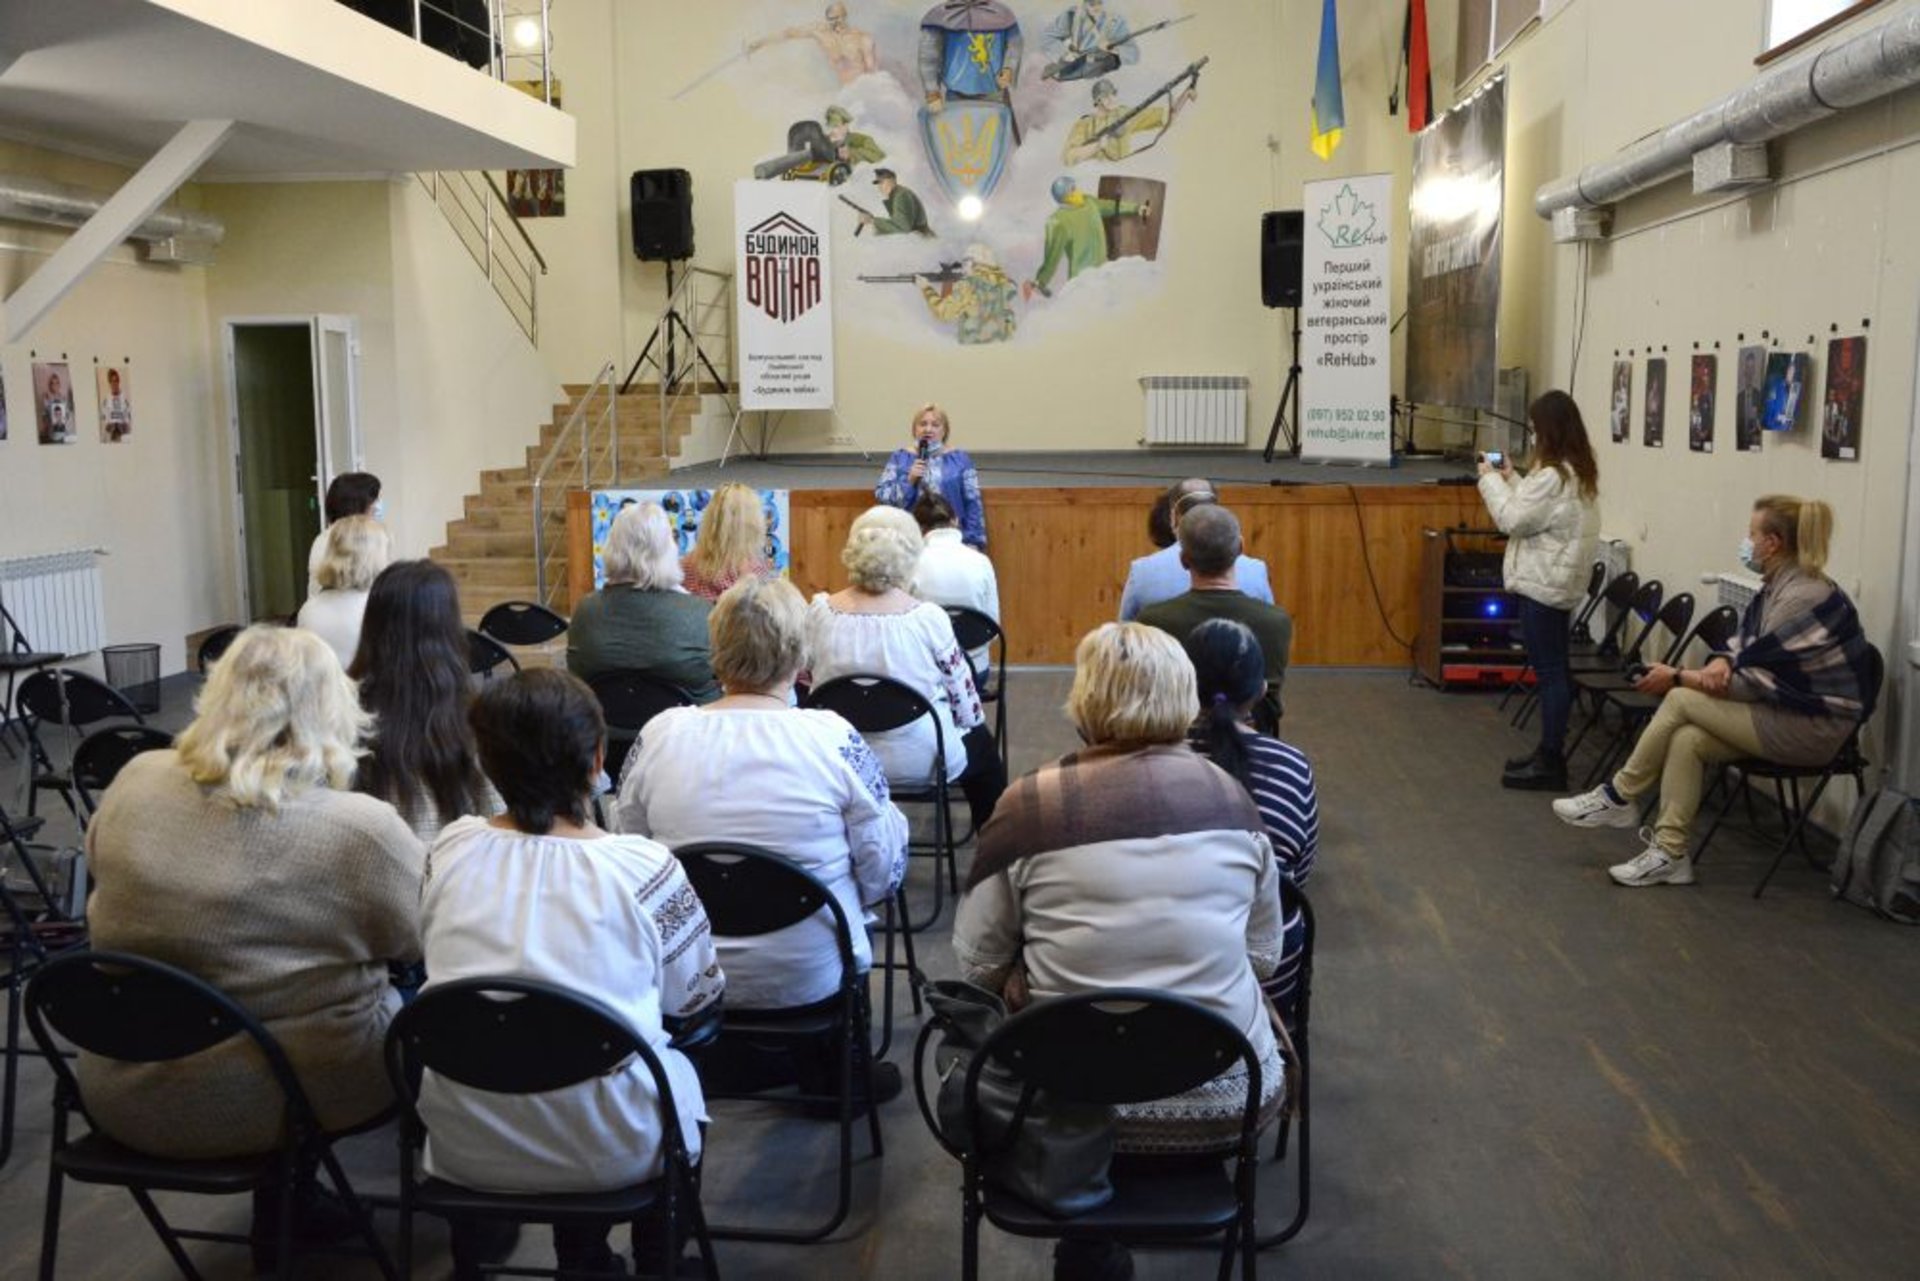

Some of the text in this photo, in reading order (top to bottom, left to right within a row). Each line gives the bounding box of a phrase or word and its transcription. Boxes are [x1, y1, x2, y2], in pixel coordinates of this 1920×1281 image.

[745, 234, 820, 256] БУДИНОК
[1324, 258, 1371, 275] Перший
[1312, 276, 1382, 295] український
[1322, 296, 1371, 308] жіночий
[1306, 312, 1387, 329] ветеранський
[1324, 331, 1369, 346] простір
[1316, 352, 1376, 367] «ReHub»
[1356, 409, 1370, 421] 02
[1307, 426, 1386, 442] rehub@ukr.net
